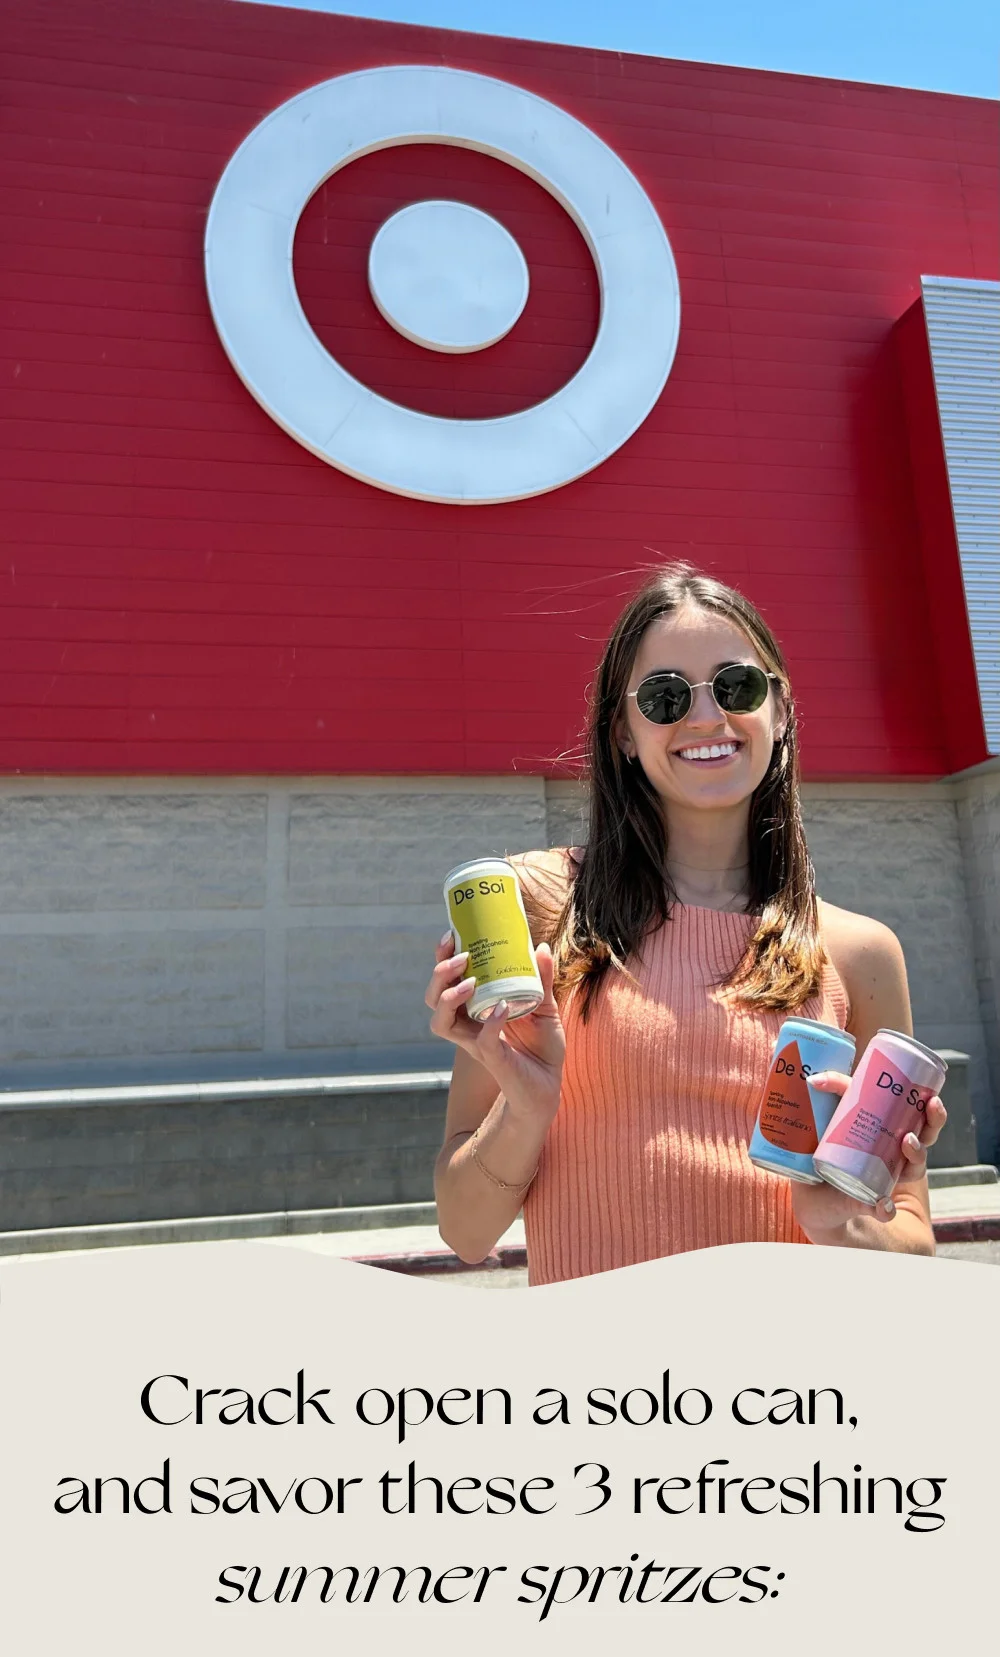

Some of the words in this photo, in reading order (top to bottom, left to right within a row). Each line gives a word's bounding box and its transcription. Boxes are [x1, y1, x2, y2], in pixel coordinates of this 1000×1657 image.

[453, 888, 475, 906] De
[478, 878, 505, 895] Soi
[469, 939, 509, 954] Non-Alcoholic
[775, 1058, 795, 1077] De
[876, 1071, 904, 1096] De
[768, 1095, 801, 1109] Non-Alcoholic
